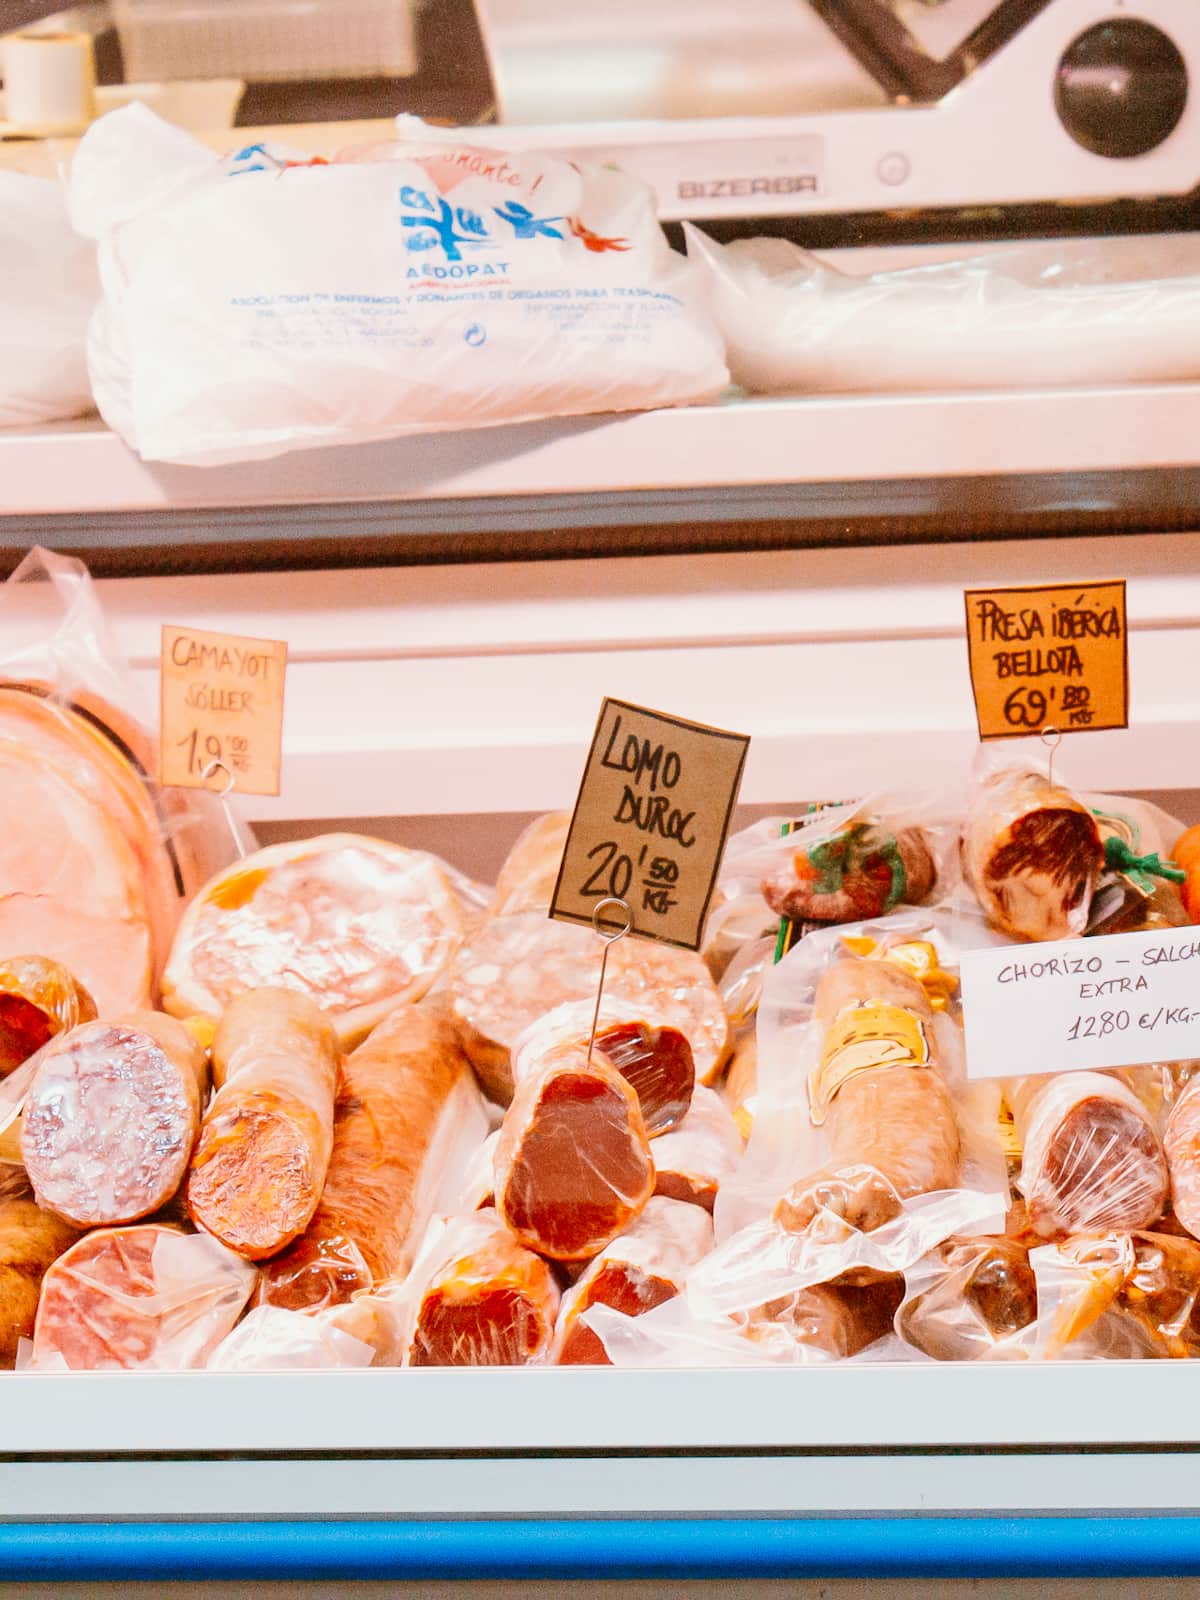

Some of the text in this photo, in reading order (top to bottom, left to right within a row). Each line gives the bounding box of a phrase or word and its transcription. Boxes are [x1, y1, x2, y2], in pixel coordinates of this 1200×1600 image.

[677, 175, 817, 200] BIZERBA
[976, 599, 1044, 642] PRESA
[171, 636, 275, 680] CAMAYOT
[993, 645, 1084, 680] BELLOTA
[601, 714, 682, 791] LOMO
[613, 785, 697, 848] DUROC
[1079, 975, 1149, 999] EXTRA
[1066, 1009, 1131, 1041] 12,80
